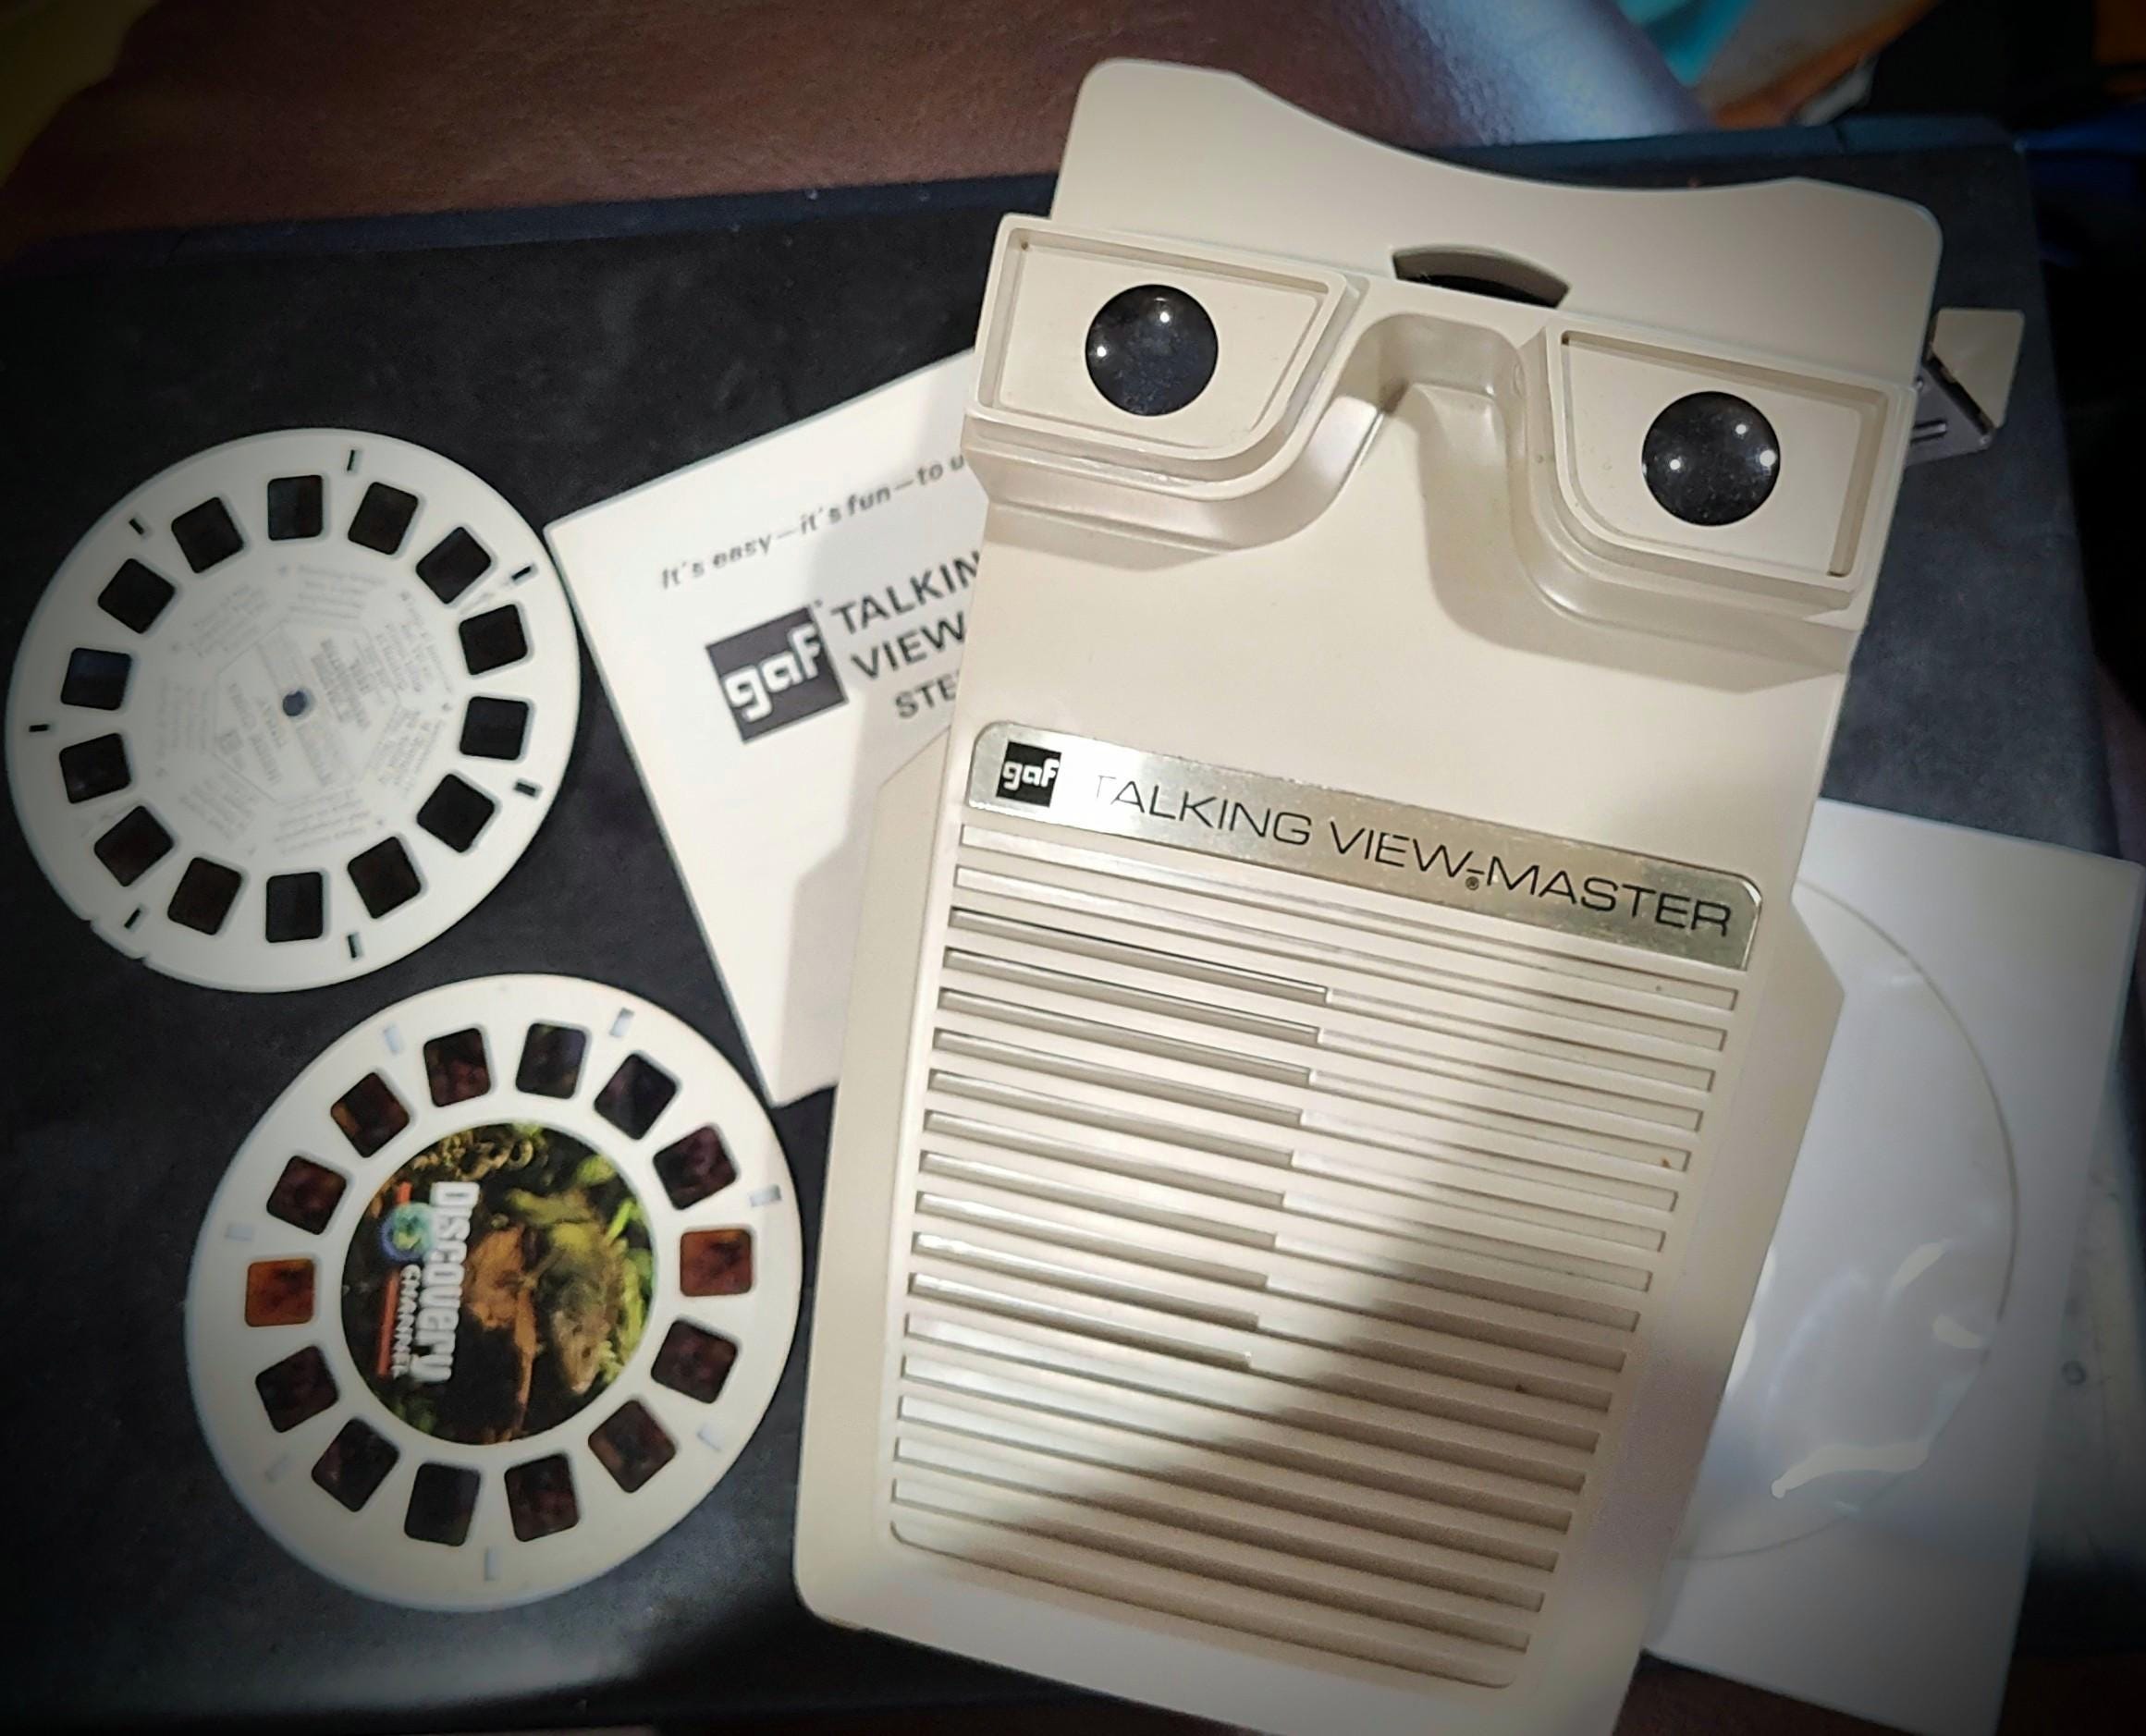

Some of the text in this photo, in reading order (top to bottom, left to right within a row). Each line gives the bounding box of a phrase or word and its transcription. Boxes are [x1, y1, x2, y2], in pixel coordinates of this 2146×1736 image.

[830, 549, 980, 635] TALKIN
[722, 621, 824, 723] gaf
[893, 668, 962, 719] STE
[1000, 756, 1061, 792] gaf
[1097, 774, 1314, 846] TALKING
